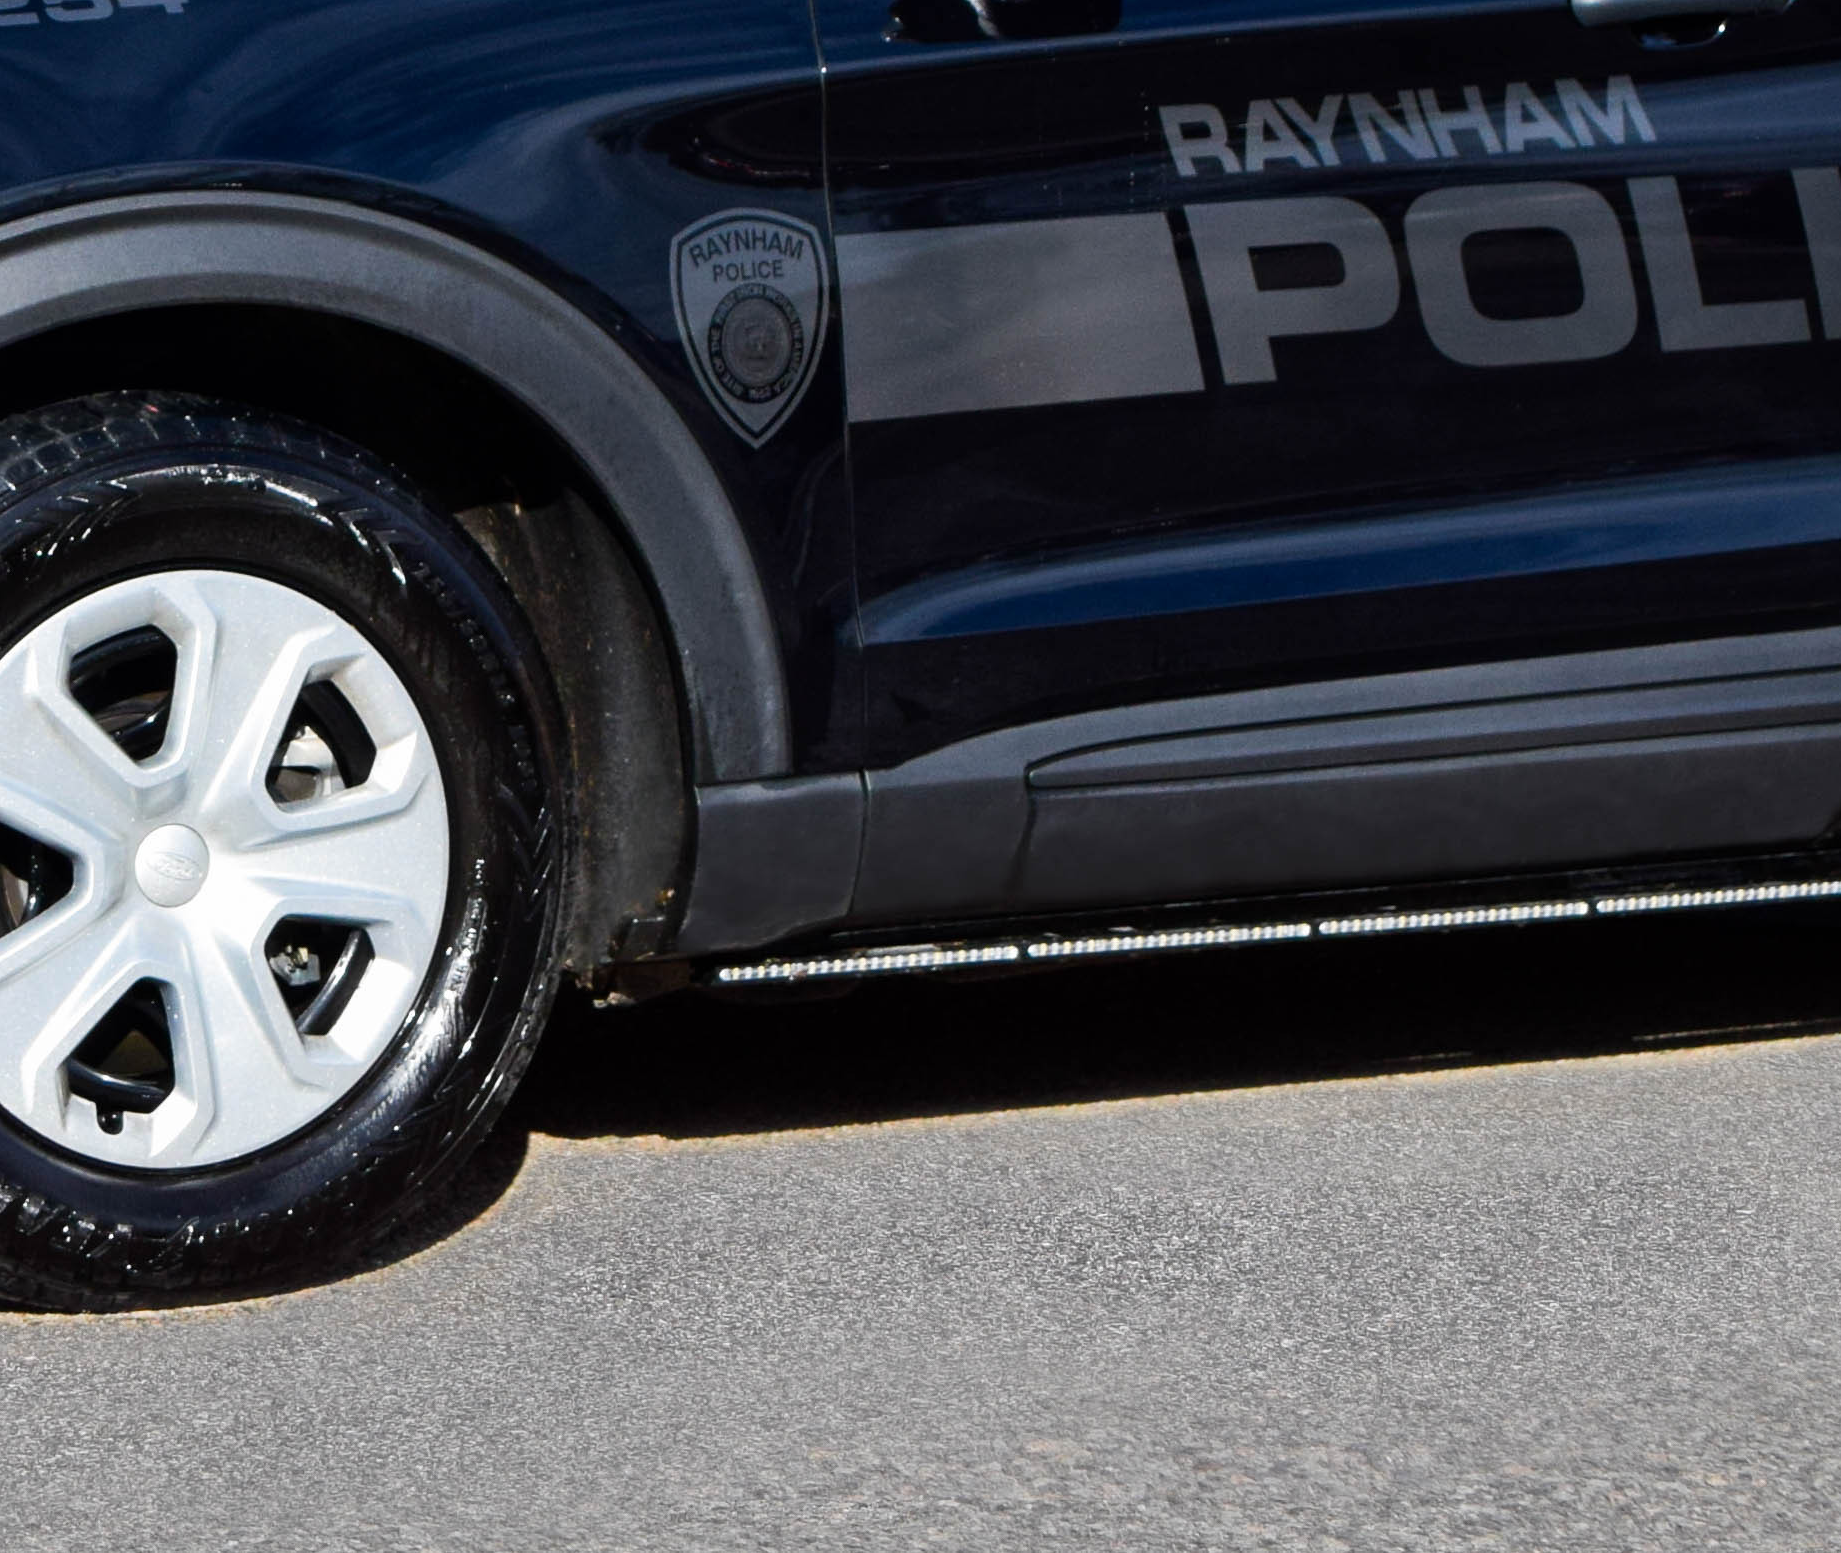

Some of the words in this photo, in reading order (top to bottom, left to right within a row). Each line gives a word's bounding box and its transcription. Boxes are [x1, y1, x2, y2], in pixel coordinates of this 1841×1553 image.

[1159, 75, 1657, 178] RAYNHAM
[689, 227, 804, 267] RAYNHAM
[712, 259, 784, 282] POLICE
